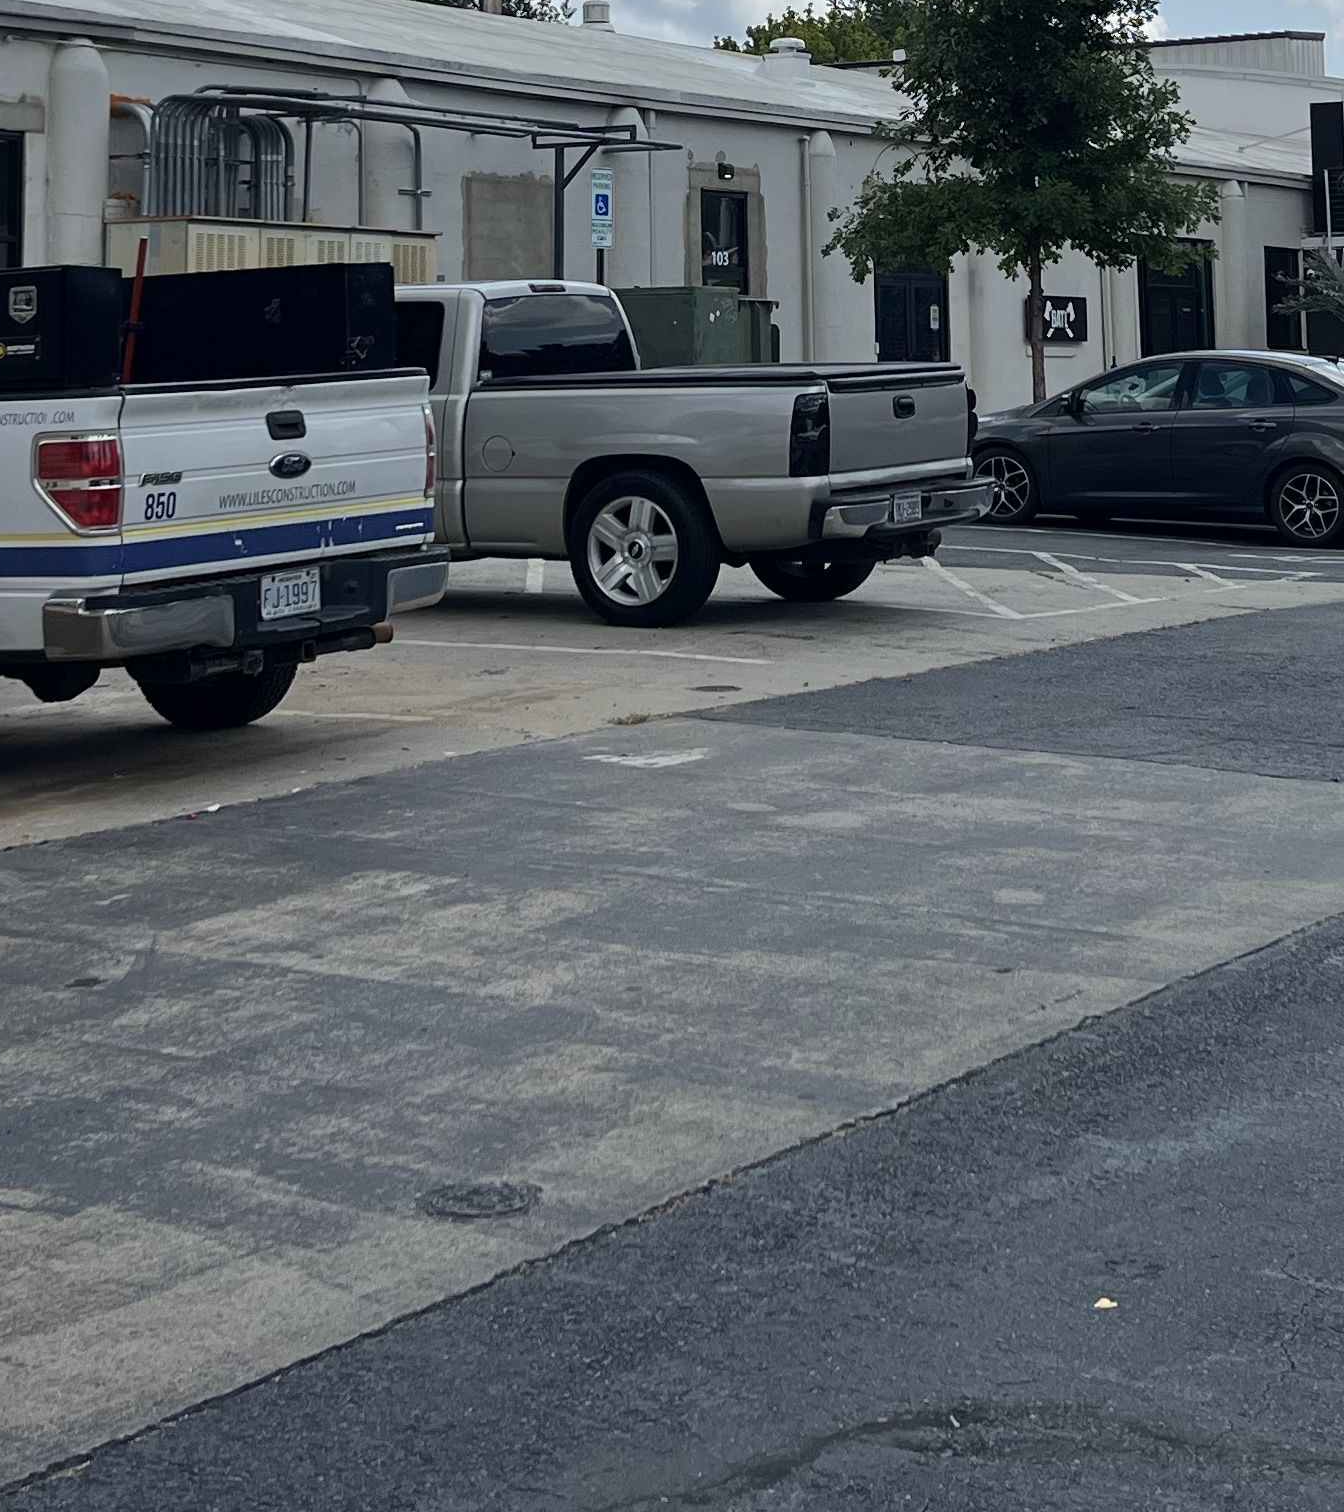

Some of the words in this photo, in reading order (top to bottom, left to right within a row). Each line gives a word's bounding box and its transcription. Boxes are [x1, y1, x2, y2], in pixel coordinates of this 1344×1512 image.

[711, 251, 730, 266] 103
[144, 491, 177, 521] 850
[219, 480, 356, 509] WWW.LILESCONSTRUCTION.COM
[263, 580, 317, 610] FJ-1997
